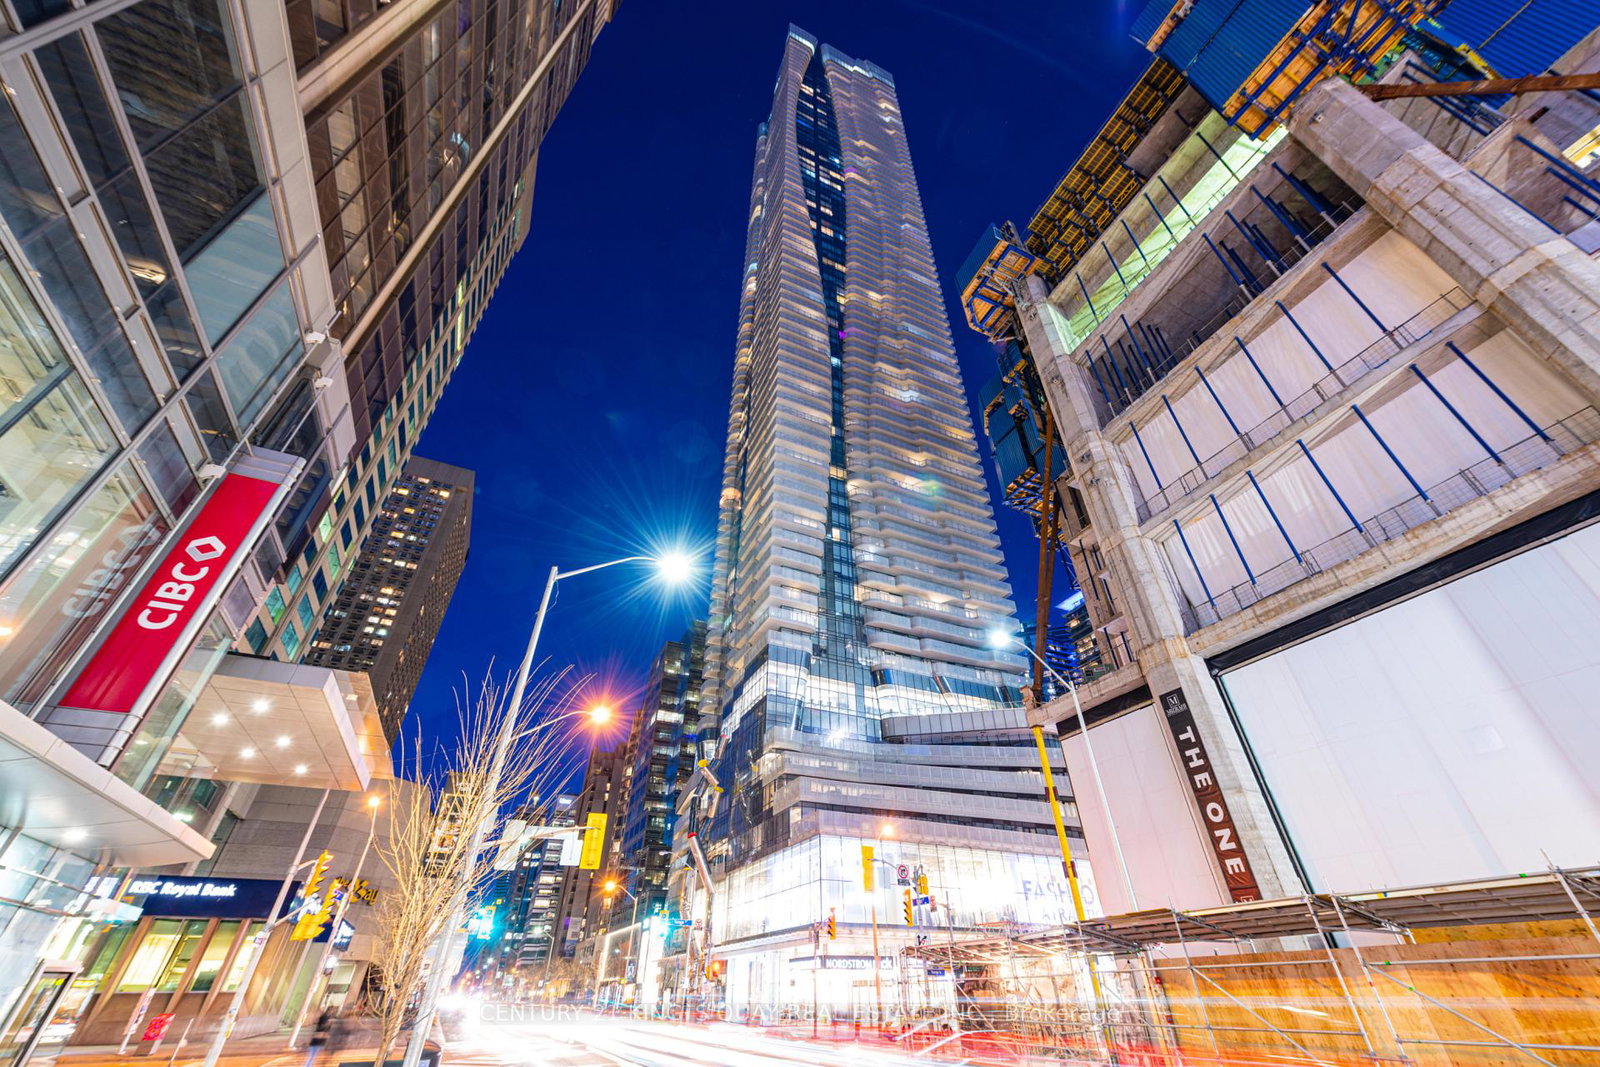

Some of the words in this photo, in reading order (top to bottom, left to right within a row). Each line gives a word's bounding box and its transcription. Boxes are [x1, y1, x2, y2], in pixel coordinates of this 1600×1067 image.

[137, 562, 209, 630] CIBC
[1178, 725, 1212, 789] THE
[1206, 802, 1246, 875] ONE
[160, 882, 203, 898] Royal
[201, 883, 237, 896] Bank
[825, 959, 872, 969] NORDSTROM
